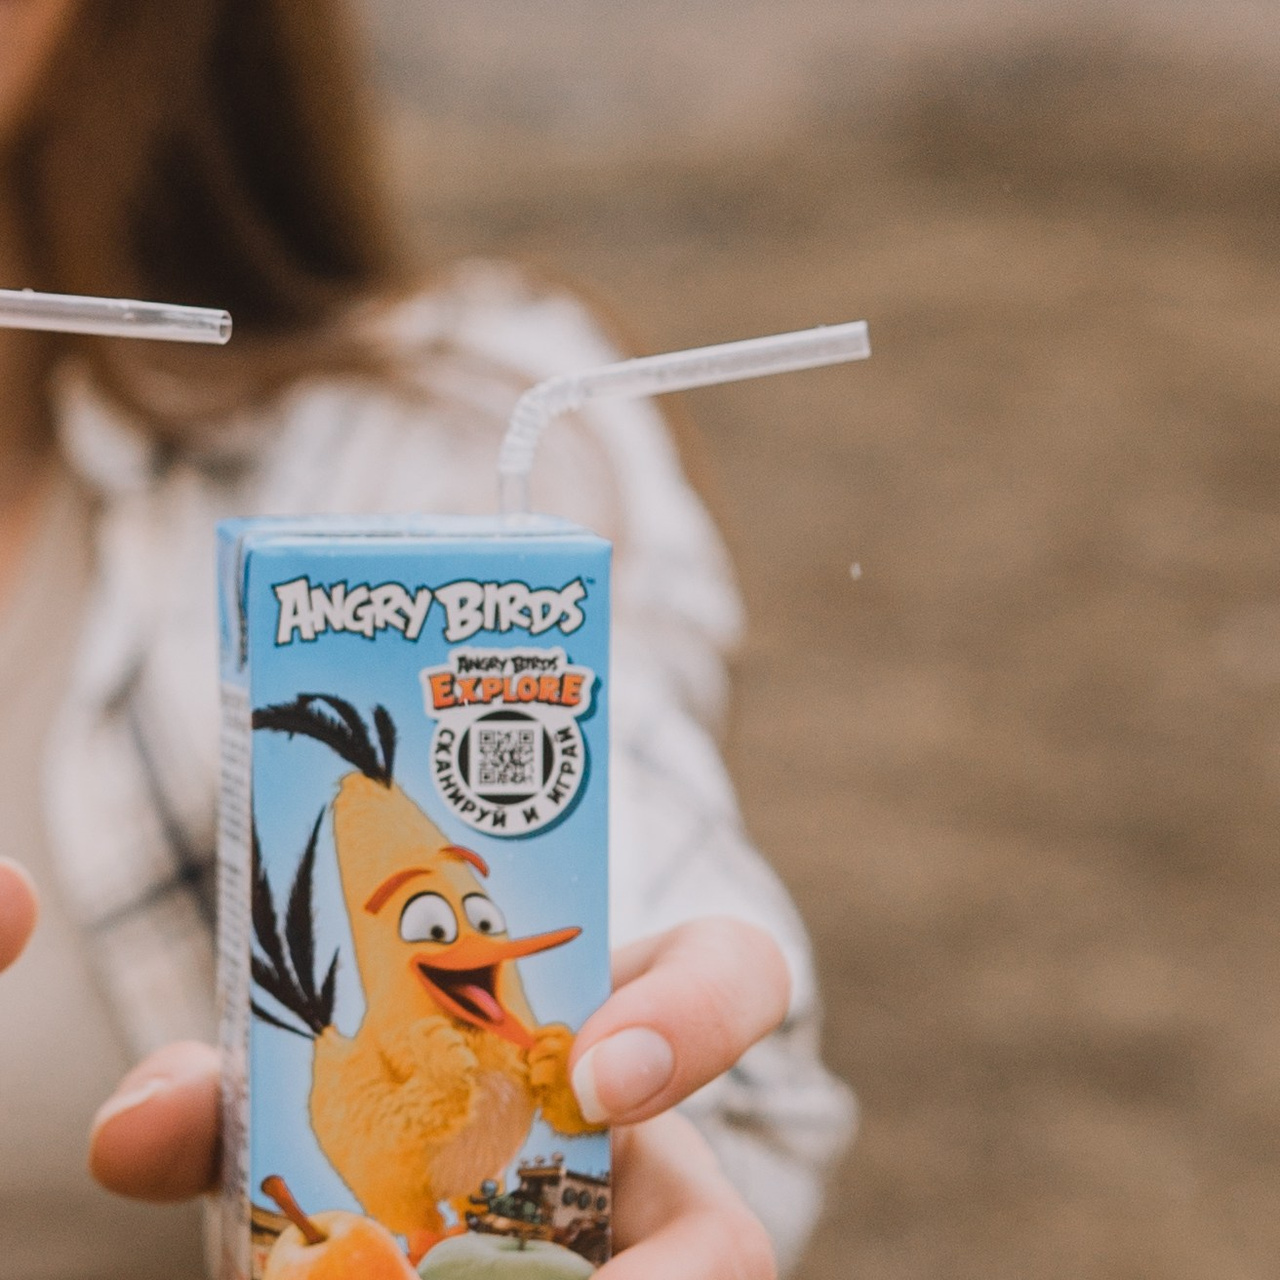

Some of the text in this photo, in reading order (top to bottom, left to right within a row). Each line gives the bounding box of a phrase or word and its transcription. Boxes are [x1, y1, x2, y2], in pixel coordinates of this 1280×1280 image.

[271, 575, 587, 647] ANGRY BIRDS
[429, 672, 585, 709] EXPLORE
[458, 656, 559, 674] ANGRY BIRDS
[435, 727, 579, 828] СКАНИРУЙ И ИГРАЙ
